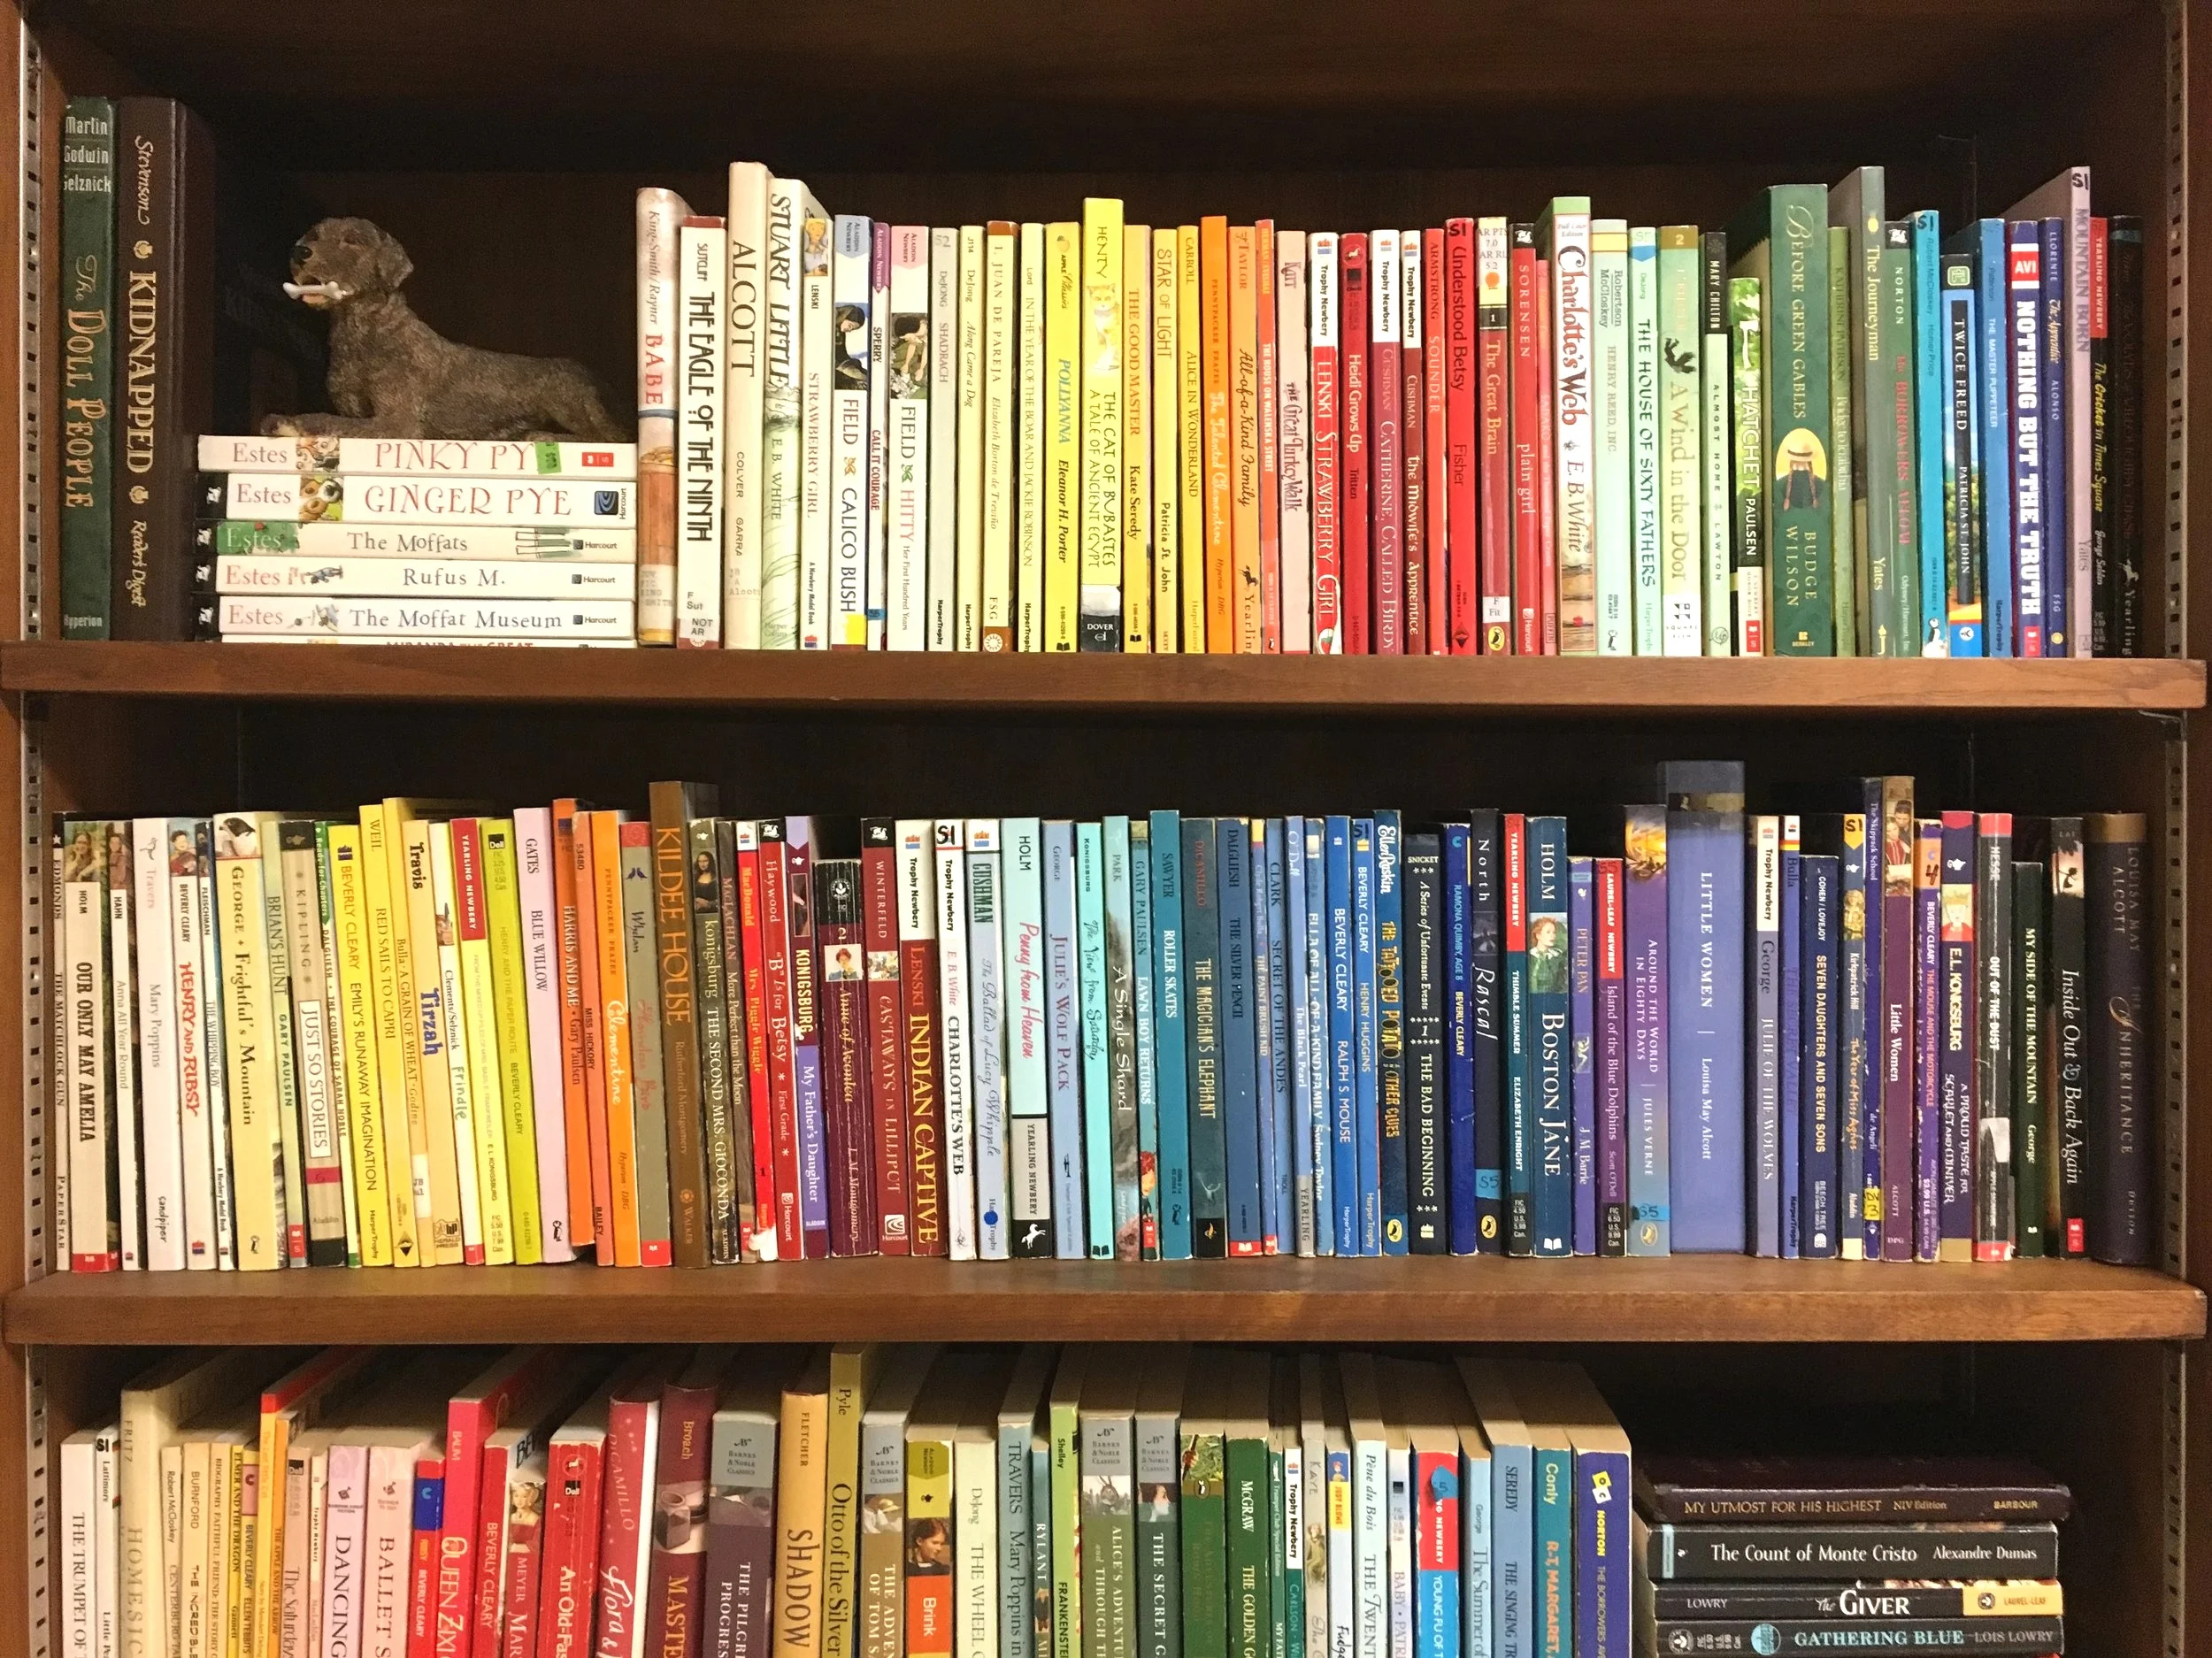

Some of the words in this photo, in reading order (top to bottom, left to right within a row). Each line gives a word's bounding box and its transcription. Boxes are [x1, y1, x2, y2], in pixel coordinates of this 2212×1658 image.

[65, 116, 108, 134] Martin
[769, 194, 791, 289] STUART
[1096, 226, 1109, 278] HENTY
[1868, 245, 1880, 275] The
[688, 294, 715, 328] THE
[732, 241, 757, 377] ALCOTT
[1452, 246, 1466, 342] Understood
[1520, 265, 1530, 357] SORENSEN
[1561, 245, 1586, 369] Charlotte's
[1865, 278, 1882, 361] Journeyman
[689, 334, 714, 396] EAGLE
[769, 303, 791, 387] LITTLE
[872, 327, 883, 363] SPERRY
[1450, 346, 1467, 391] Betsy
[1487, 340, 1501, 369] The
[1955, 319, 1966, 372] TWICE
[2016, 301, 2039, 409] NOTHING
[126, 270, 157, 473] KIDNAPPED
[645, 334, 664, 405] BABE
[1348, 354, 1362, 388] Heidi
[1103, 391, 1117, 419] THE
[1348, 390, 1361, 432] Grows
[1486, 374, 1501, 413] Great
[1560, 372, 1586, 425] Web
[1955, 380, 1967, 431] FREED
[688, 405, 714, 431] OF
[843, 399, 858, 445] FIELD
[1103, 426, 1117, 455] CAT
[1487, 418, 1501, 455] Brain
[1742, 384, 1760, 488] HATCHET
[2018, 417, 2039, 466] BUT
[65, 395, 107, 509] PEOPLE
[233, 442, 288, 463] Estes
[374, 441, 477, 470] PINKY
[688, 437, 713, 472] THE
[1348, 435, 1362, 453] Up
[1058, 459, 1069, 506] Eleanor
[1103, 464, 1117, 485] OF
[1317, 432, 1336, 563] STRAWBERRY
[2020, 473, 2039, 523] THE
[235, 483, 291, 503] Estes
[365, 489, 491, 514] GINGER
[506, 488, 572, 515] PYE
[687, 480, 713, 541] NINTH
[841, 487, 858, 558] CALICO
[1058, 510, 1069, 523] H.
[347, 532, 388, 551] The
[397, 532, 467, 552] Moffats
[585, 541, 618, 549] Harcourt
[1058, 526, 1069, 563] Porter
[1102, 491, 1117, 566] BUBASTES
[1745, 498, 1757, 556] PAULSEN
[403, 568, 466, 586] Rufus
[478, 569, 504, 586] M.
[1786, 526, 1800, 607] WILSON
[1804, 532, 1817, 600] BUDGE
[1874, 557, 1886, 590] Yates
[2021, 531, 2041, 615] TRUTH
[841, 567, 856, 613] BUSH
[1318, 574, 1337, 621] GIRL
[349, 609, 388, 627] The
[398, 609, 465, 627] Moffat
[476, 610, 562, 628] Museum
[410, 842, 426, 889] Travis
[526, 839, 539, 873] GATES
[656, 827, 687, 923] KILDEE
[1541, 843, 1555, 900] HOLM
[79, 890, 88, 914] HOLM
[972, 863, 993, 924] CUSHMAN
[1700, 872, 1713, 934] LITTLE
[531, 910, 545, 940] BLUE
[1018, 922, 1040, 963] Penny
[1333, 909, 1347, 960] BEVERLY
[76, 963, 93, 994] OUR
[533, 944, 548, 992] WILLOW
[664, 933, 690, 1026] HOUSE
[795, 949, 814, 1033] KONIGSBURG
[1020, 969, 1041, 1003] from
[1195, 958, 1212, 982] THE
[1334, 963, 1348, 1011] CLEARY
[1700, 941, 1713, 1008] WOMEN
[148, 984, 162, 1015] Mary
[180, 963, 195, 1025] HENRY
[350, 983, 365, 1026] EMILY'S
[1473, 967, 1498, 1040] Rascal
[2062, 971, 2079, 1019] Inside
[77, 1000, 93, 1039] ONLY
[184, 1029, 193, 1054] AND
[303, 1010, 321, 1048] JUST
[421, 987, 442, 1055] Tirzah
[1020, 1006, 1042, 1058] Heaven
[1196, 986, 1215, 1053] MAGICIAN'S
[1889, 1003, 1903, 1034] Little
[2062, 1025, 2079, 1058] Out
[78, 1046, 94, 1078] MAY
[149, 1020, 164, 1067] Poppins
[308, 1055, 321, 1075] SO
[355, 1031, 370, 1095] RUNAWAY
[609, 1001, 627, 1105] Clementine
[910, 1013, 932, 1117] INDIAN
[1541, 1013, 1563, 1110] BOSTON
[1889, 1038, 1902, 1081] Women
[183, 1057, 199, 1117] RIBSY
[947, 1016, 964, 1134] CHARLOTTE'S
[1199, 1059, 1217, 1118] ELEPHANT
[1419, 1054, 1432, 1082] THE
[79, 1083, 96, 1141] AMELIA
[310, 1080, 327, 1148] STORIES
[1420, 1086, 1432, 1114] BAD
[2065, 1086, 2080, 1128] Back
[360, 1101, 378, 1190] IMAGINATION
[951, 1138, 964, 1175] WEB
[1421, 1118, 1433, 1197] BEGINNING
[1540, 1117, 1564, 1176] JANE
[2064, 1133, 2083, 1185] Again
[915, 1124, 937, 1243] CAPTIVE
[837, 1388, 851, 1416] Pyle
[680, 1421, 695, 1460] Broach
[800, 1412, 810, 1467] FLETCHER
[1056, 1439, 1066, 1468] Shelley
[1240, 1481, 1254, 1532] McGRAW
[1289, 1484, 1298, 1515] Trophy
[1505, 1465, 1517, 1512] SEREDY
[1543, 1462, 1558, 1504] Conly
[72, 1512, 85, 1547] THE
[831, 1483, 851, 1532] Otto
[484, 1522, 497, 1575] BEVERLY
[831, 1537, 849, 1559] of
[1036, 1523, 1046, 1580] RYLANT
[1597, 1510, 1606, 1556] NORTON
[1711, 1544, 1739, 1561] The
[1745, 1544, 1792, 1562] Count
[1796, 1543, 1812, 1561] of
[1818, 1546, 1866, 1562] Monte
[1872, 1545, 1917, 1562] Cristo
[73, 1550, 87, 1623] TRUMPET
[829, 1562, 848, 1593] the
[480, 1579, 495, 1628] CLEARY
[923, 1597, 937, 1637] Brink
[1839, 1590, 1909, 1615] GIVER
[827, 1597, 849, 1656] Silver
[1794, 1631, 1908, 1646] GATHERING
[1914, 1631, 1963, 1645] BLUE
